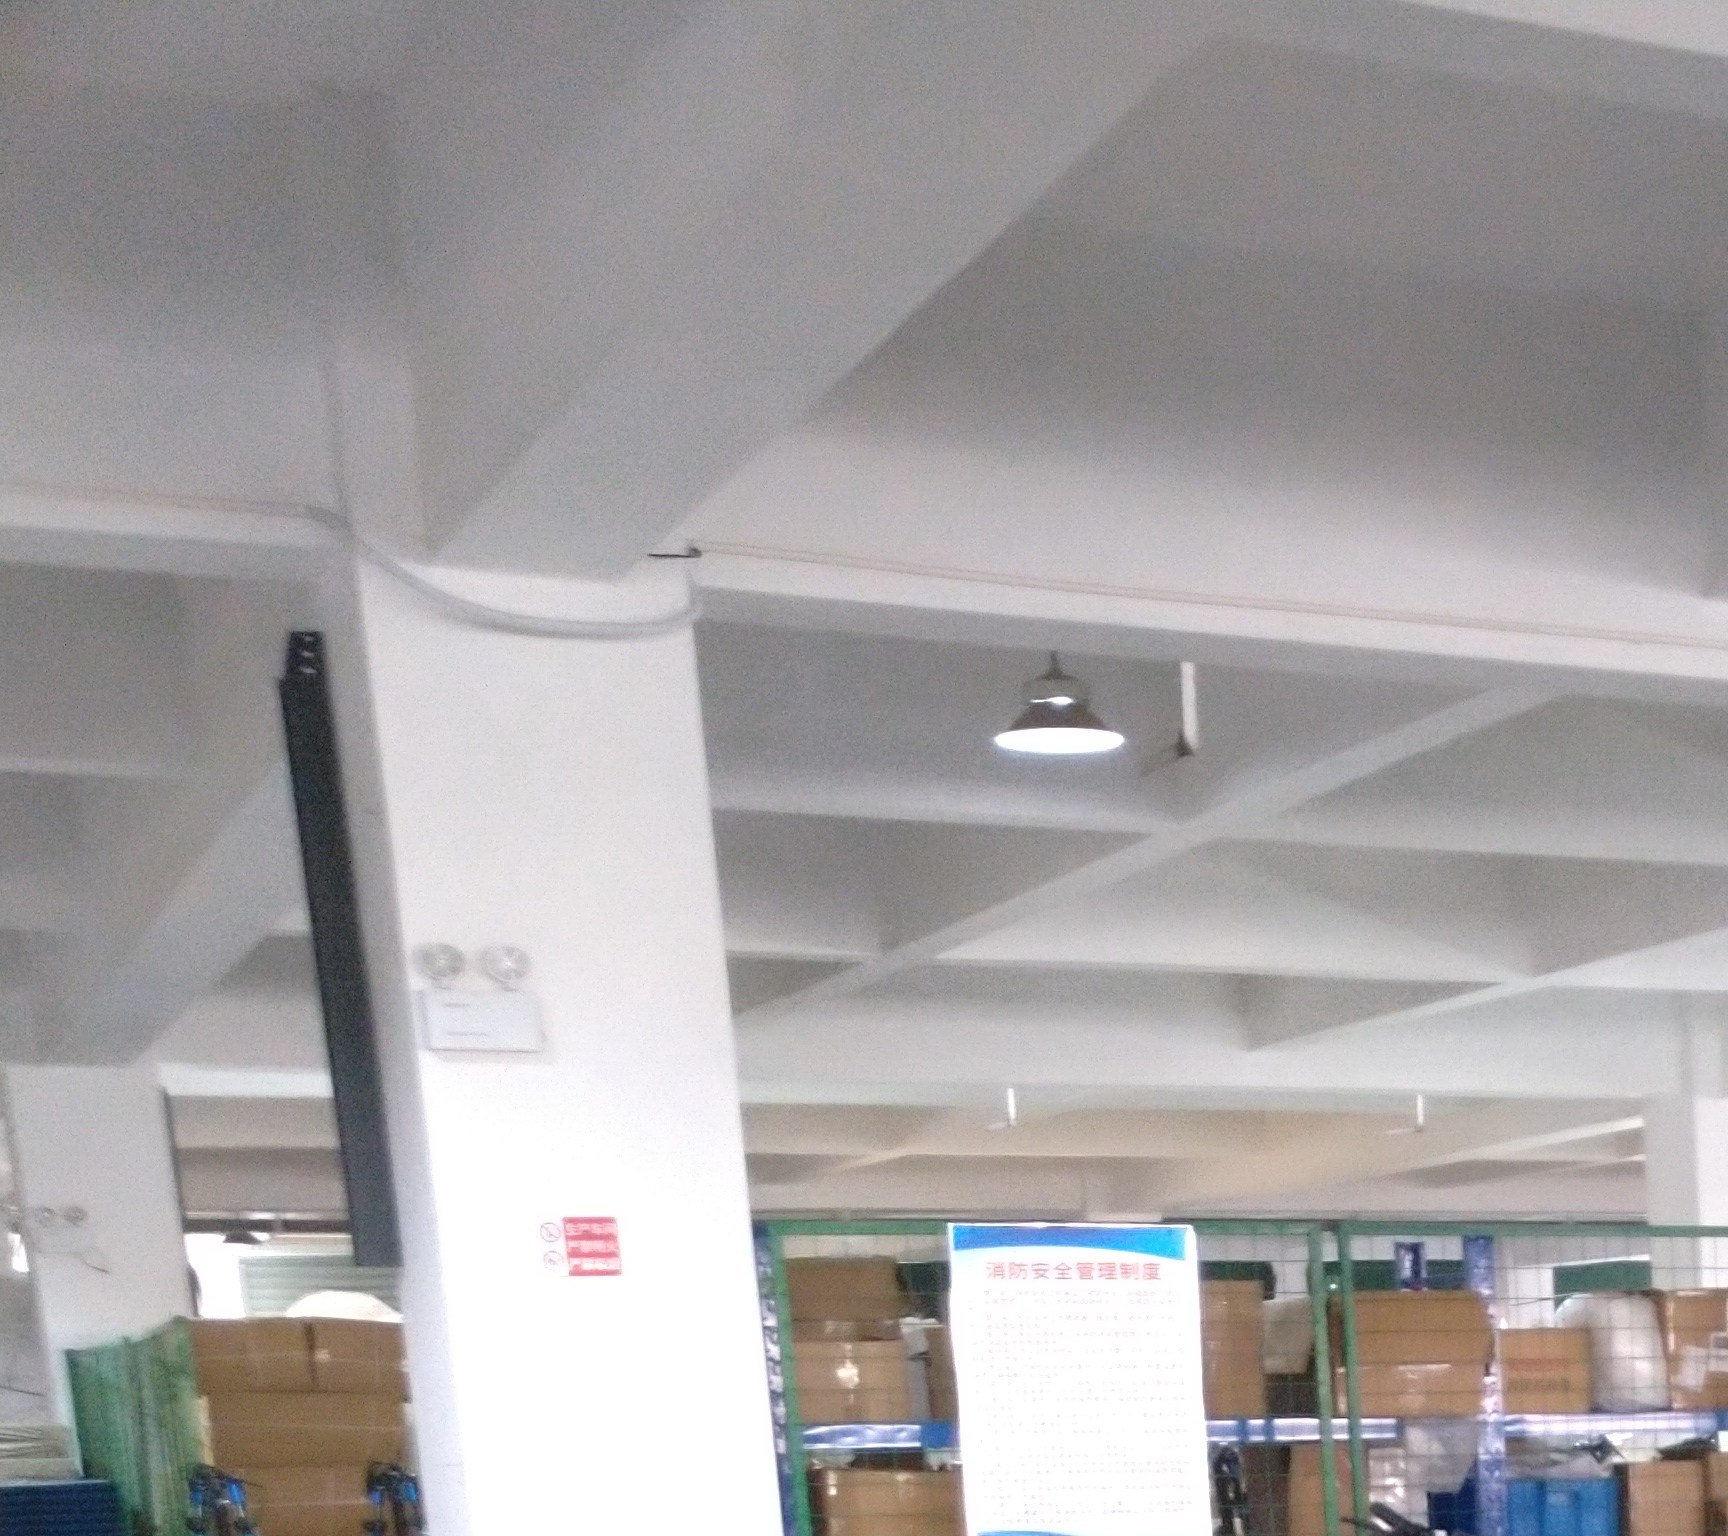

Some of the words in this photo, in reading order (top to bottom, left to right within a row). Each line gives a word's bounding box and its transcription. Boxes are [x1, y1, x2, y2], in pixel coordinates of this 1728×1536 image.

[985, 1261, 1162, 1281] 消防安全管理制度
